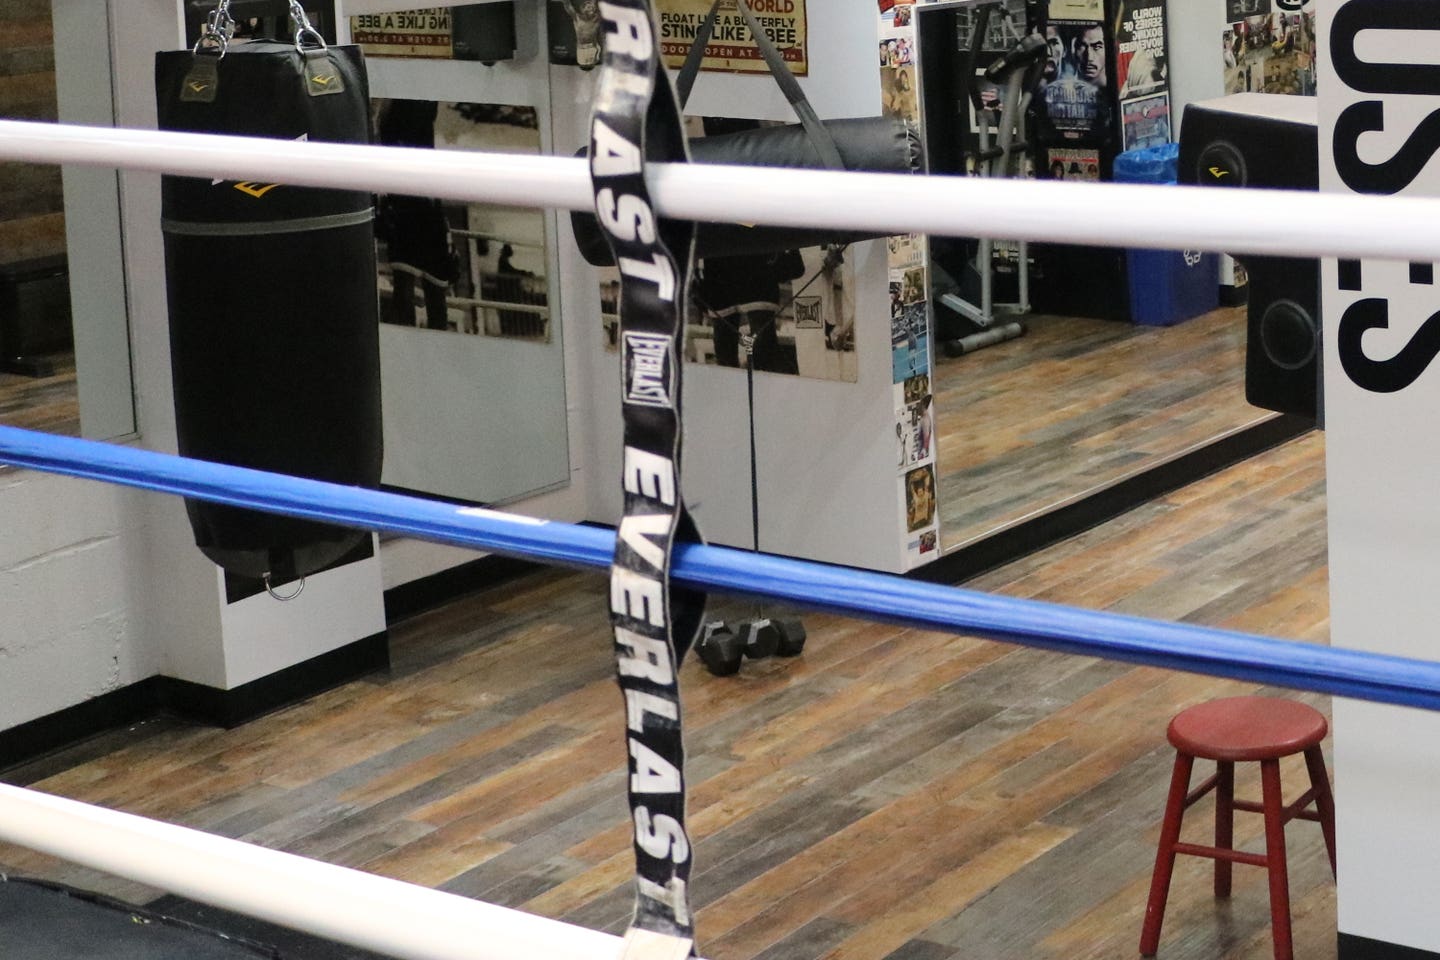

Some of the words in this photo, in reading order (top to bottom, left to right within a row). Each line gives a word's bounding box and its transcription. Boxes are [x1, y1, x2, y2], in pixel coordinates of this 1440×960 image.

[661, 12, 695, 24] FLOAT
[724, 16, 731, 26] A
[734, 16, 796, 28] BUTERFLY
[712, 26, 745, 41] LIKE
[662, 46, 690, 55] DOO
[626, 336, 670, 404] EVERLAST
[611, 446, 691, 928] EVERLAST
